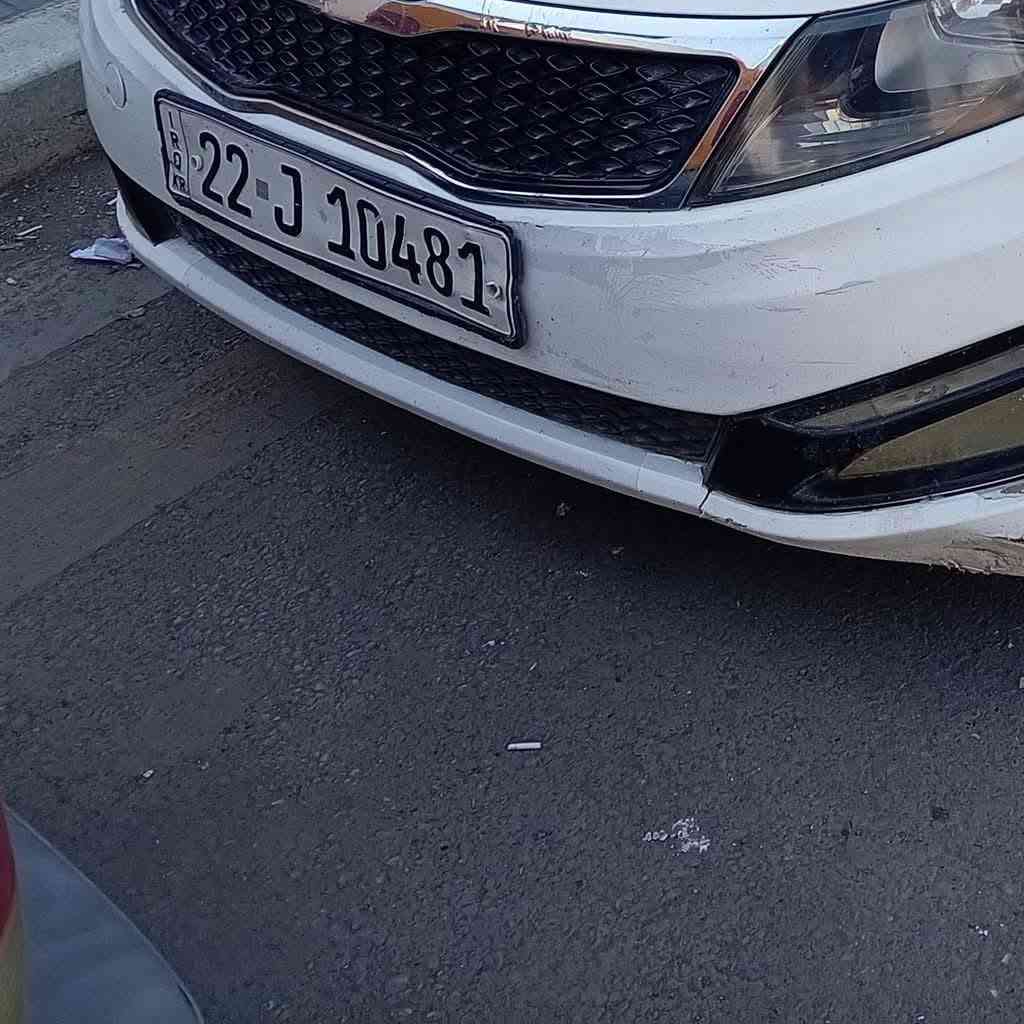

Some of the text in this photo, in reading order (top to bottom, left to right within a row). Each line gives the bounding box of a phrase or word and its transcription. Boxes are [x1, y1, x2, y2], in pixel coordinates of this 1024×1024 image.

[199, 131, 492, 317] 22 J 10481
